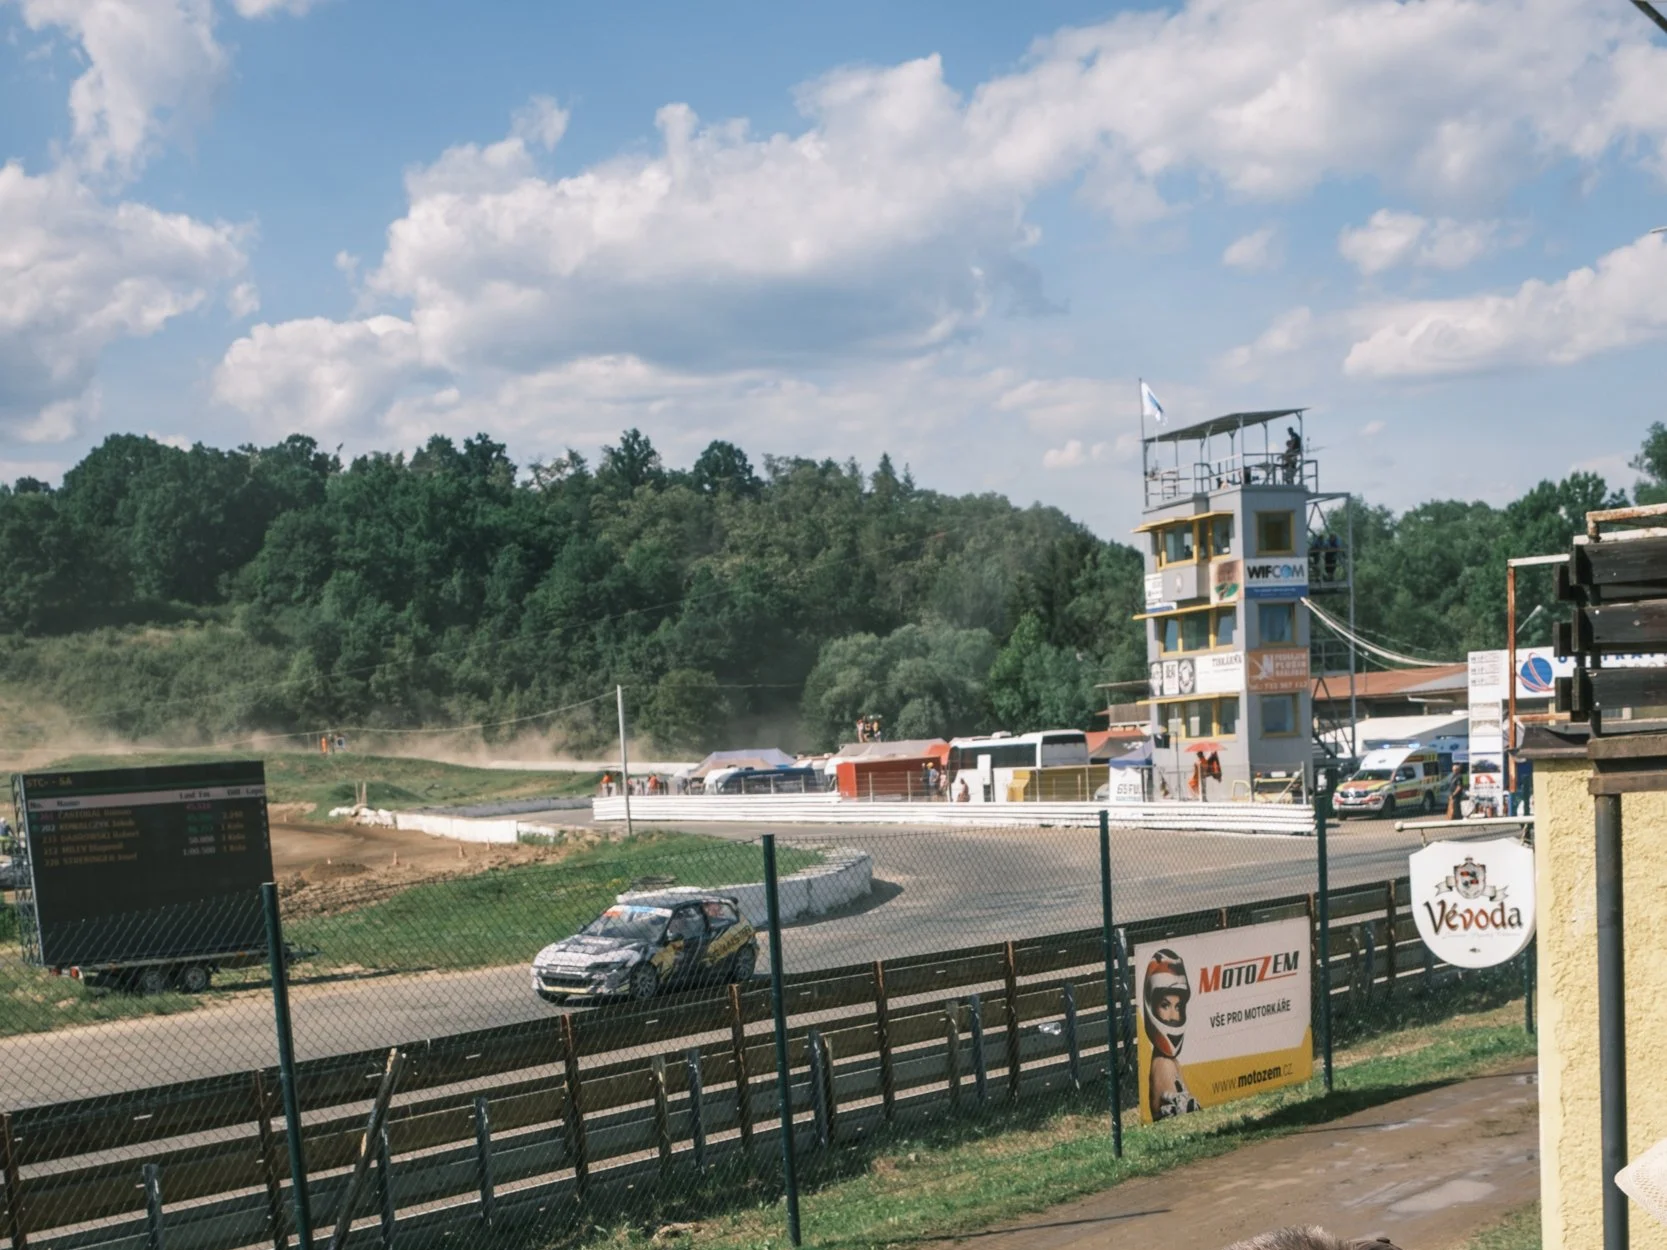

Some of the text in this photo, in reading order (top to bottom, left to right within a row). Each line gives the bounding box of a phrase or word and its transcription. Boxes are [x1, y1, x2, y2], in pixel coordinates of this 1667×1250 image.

[1246, 563, 1305, 579] WIFCOM
[1423, 899, 1523, 936] Vévoda
[1210, 999, 1291, 1028] VŠE PRO MOTORKÁŘE
[1211, 1062, 1294, 1095] www.motozem.cz
